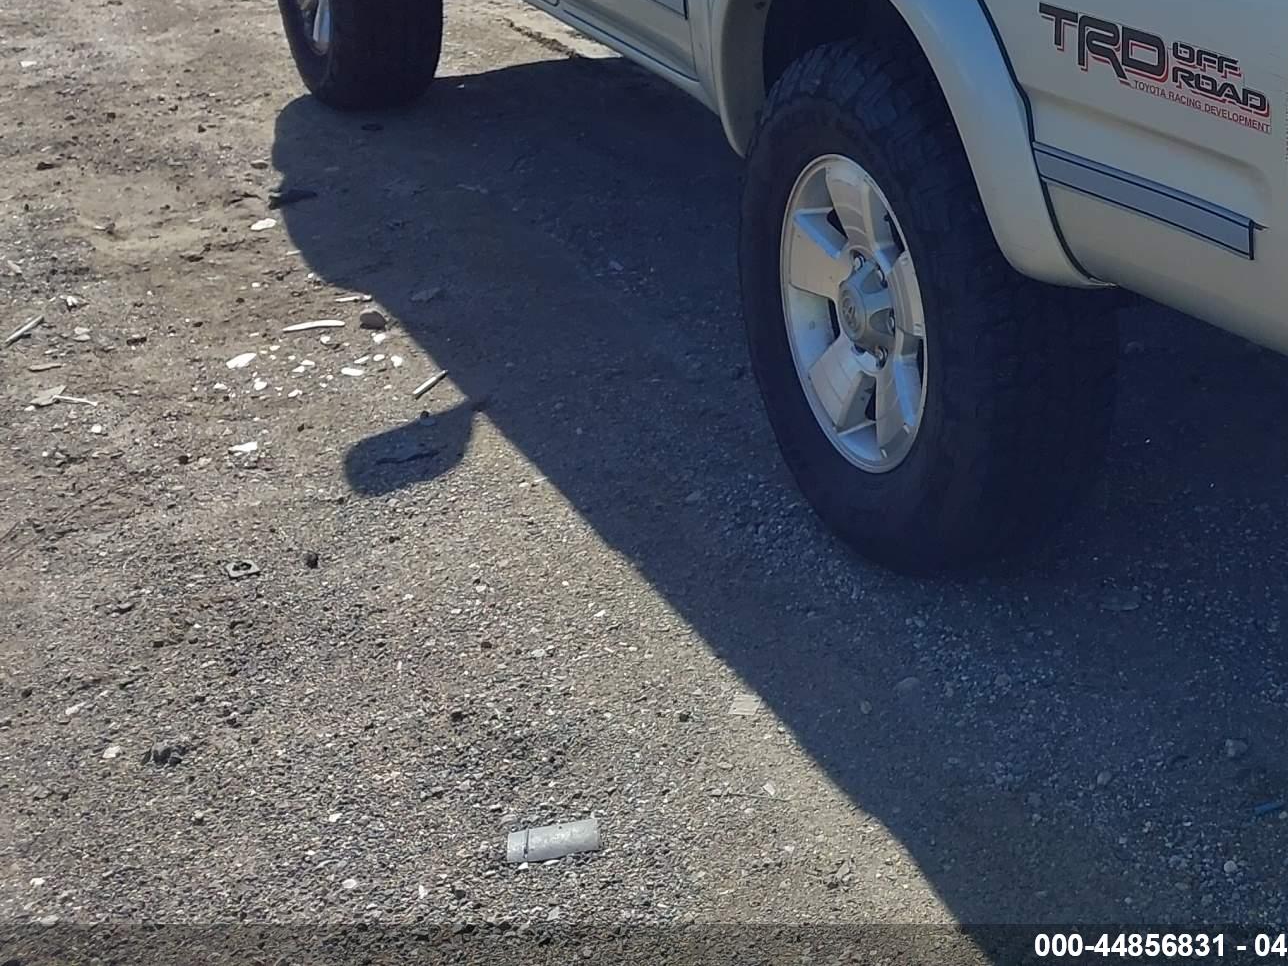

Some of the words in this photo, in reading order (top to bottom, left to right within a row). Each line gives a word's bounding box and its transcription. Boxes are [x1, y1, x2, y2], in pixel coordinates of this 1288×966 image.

[1038, 0, 1169, 87] TRD
[1171, 41, 1243, 79] OFF
[1133, 79, 1167, 97] TOYOTA
[1168, 89, 1202, 111] RACING
[1204, 102, 1272, 134] DEVELOPMENT
[1171, 66, 1271, 118] ROAD
